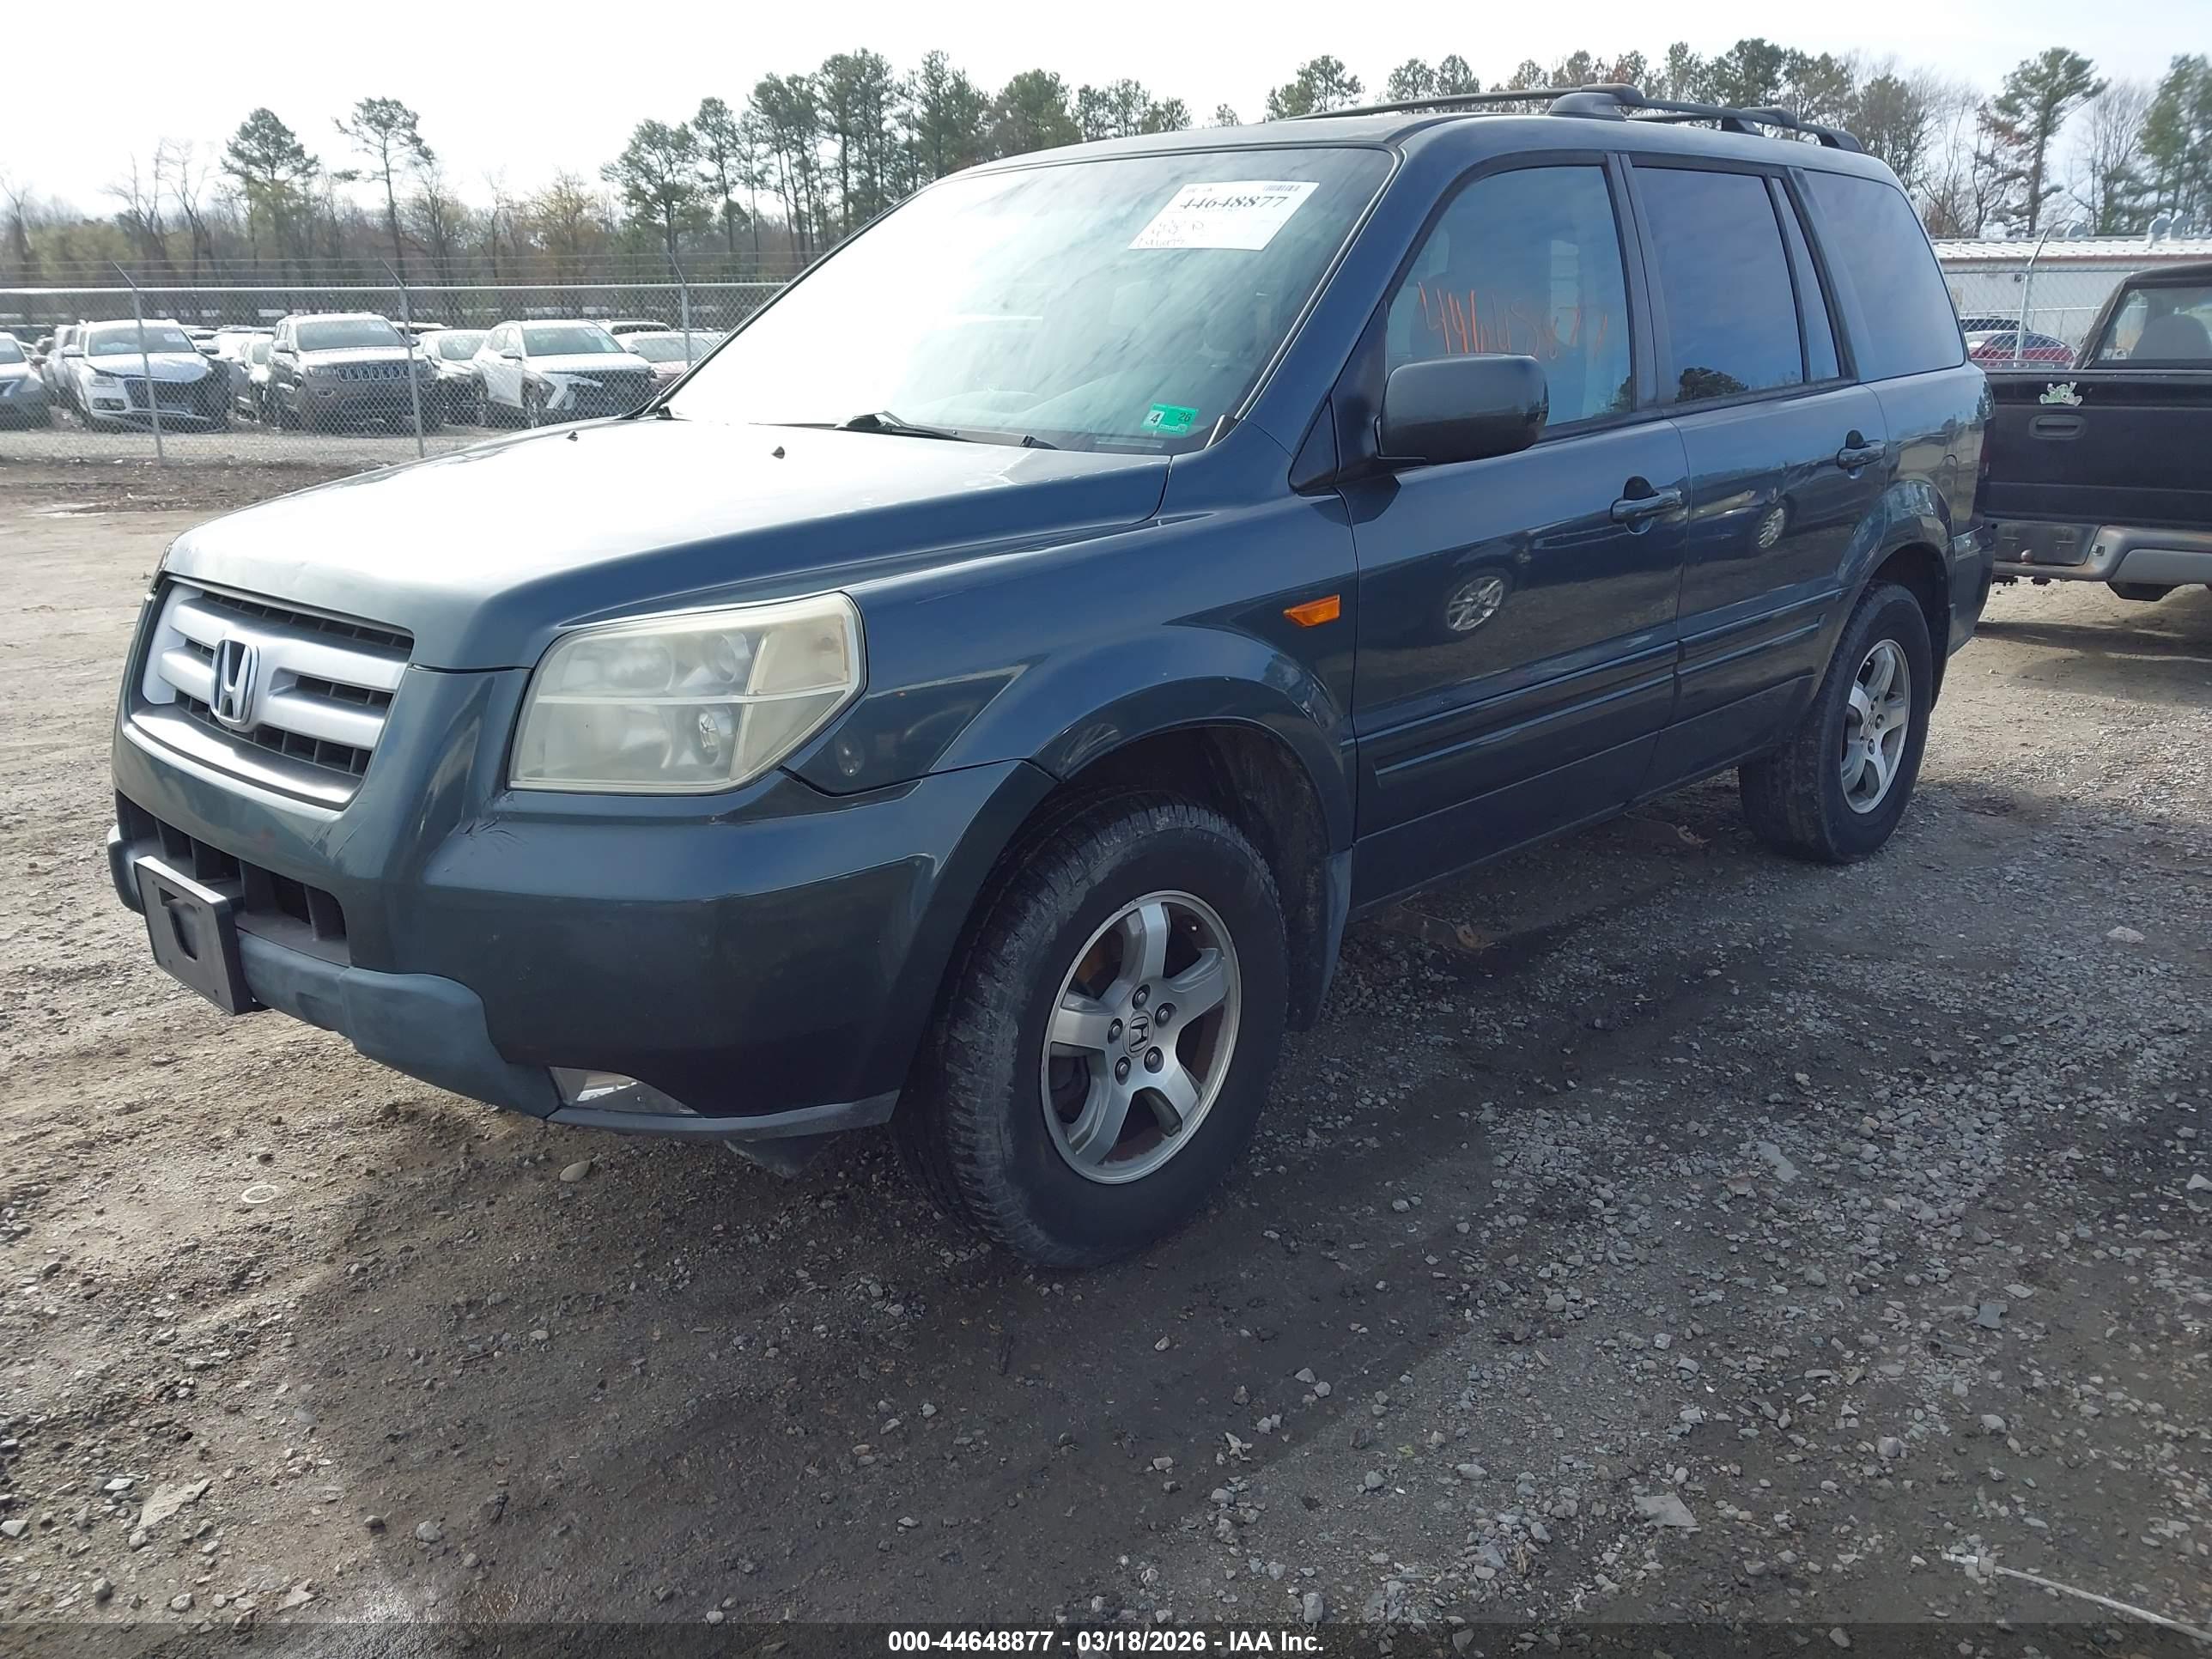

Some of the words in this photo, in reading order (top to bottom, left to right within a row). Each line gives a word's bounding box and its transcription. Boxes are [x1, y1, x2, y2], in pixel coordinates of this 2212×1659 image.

[1180, 196, 1289, 210] 44648877
[1151, 412, 1161, 423] 4
[1177, 412, 1193, 422] 26
